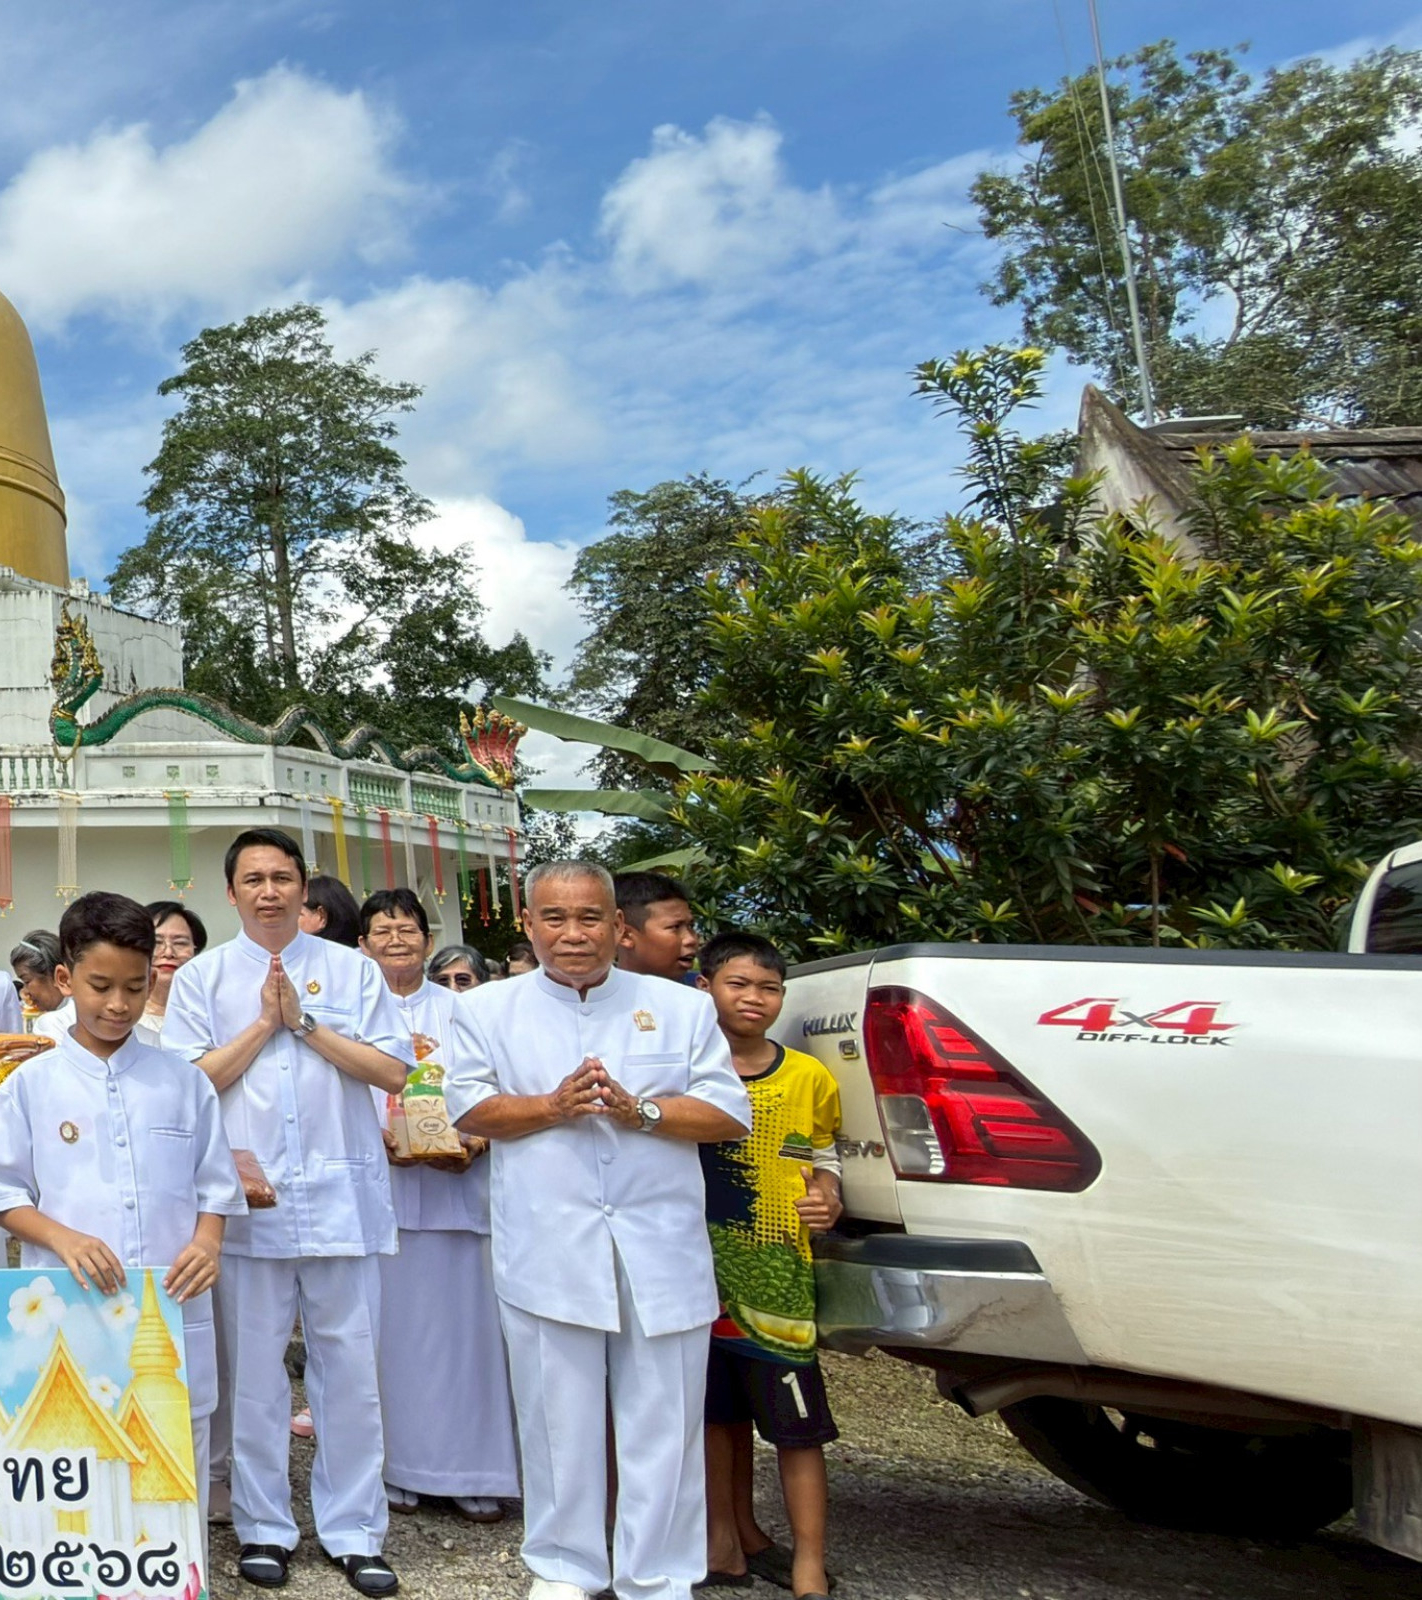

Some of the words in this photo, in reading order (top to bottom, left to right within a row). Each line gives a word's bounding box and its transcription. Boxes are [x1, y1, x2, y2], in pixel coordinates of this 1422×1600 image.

[803, 1012, 857, 1036] HILUX
[1076, 1032, 1232, 1046] DIFF-LOCK
[781, 1371, 808, 1419] 1
